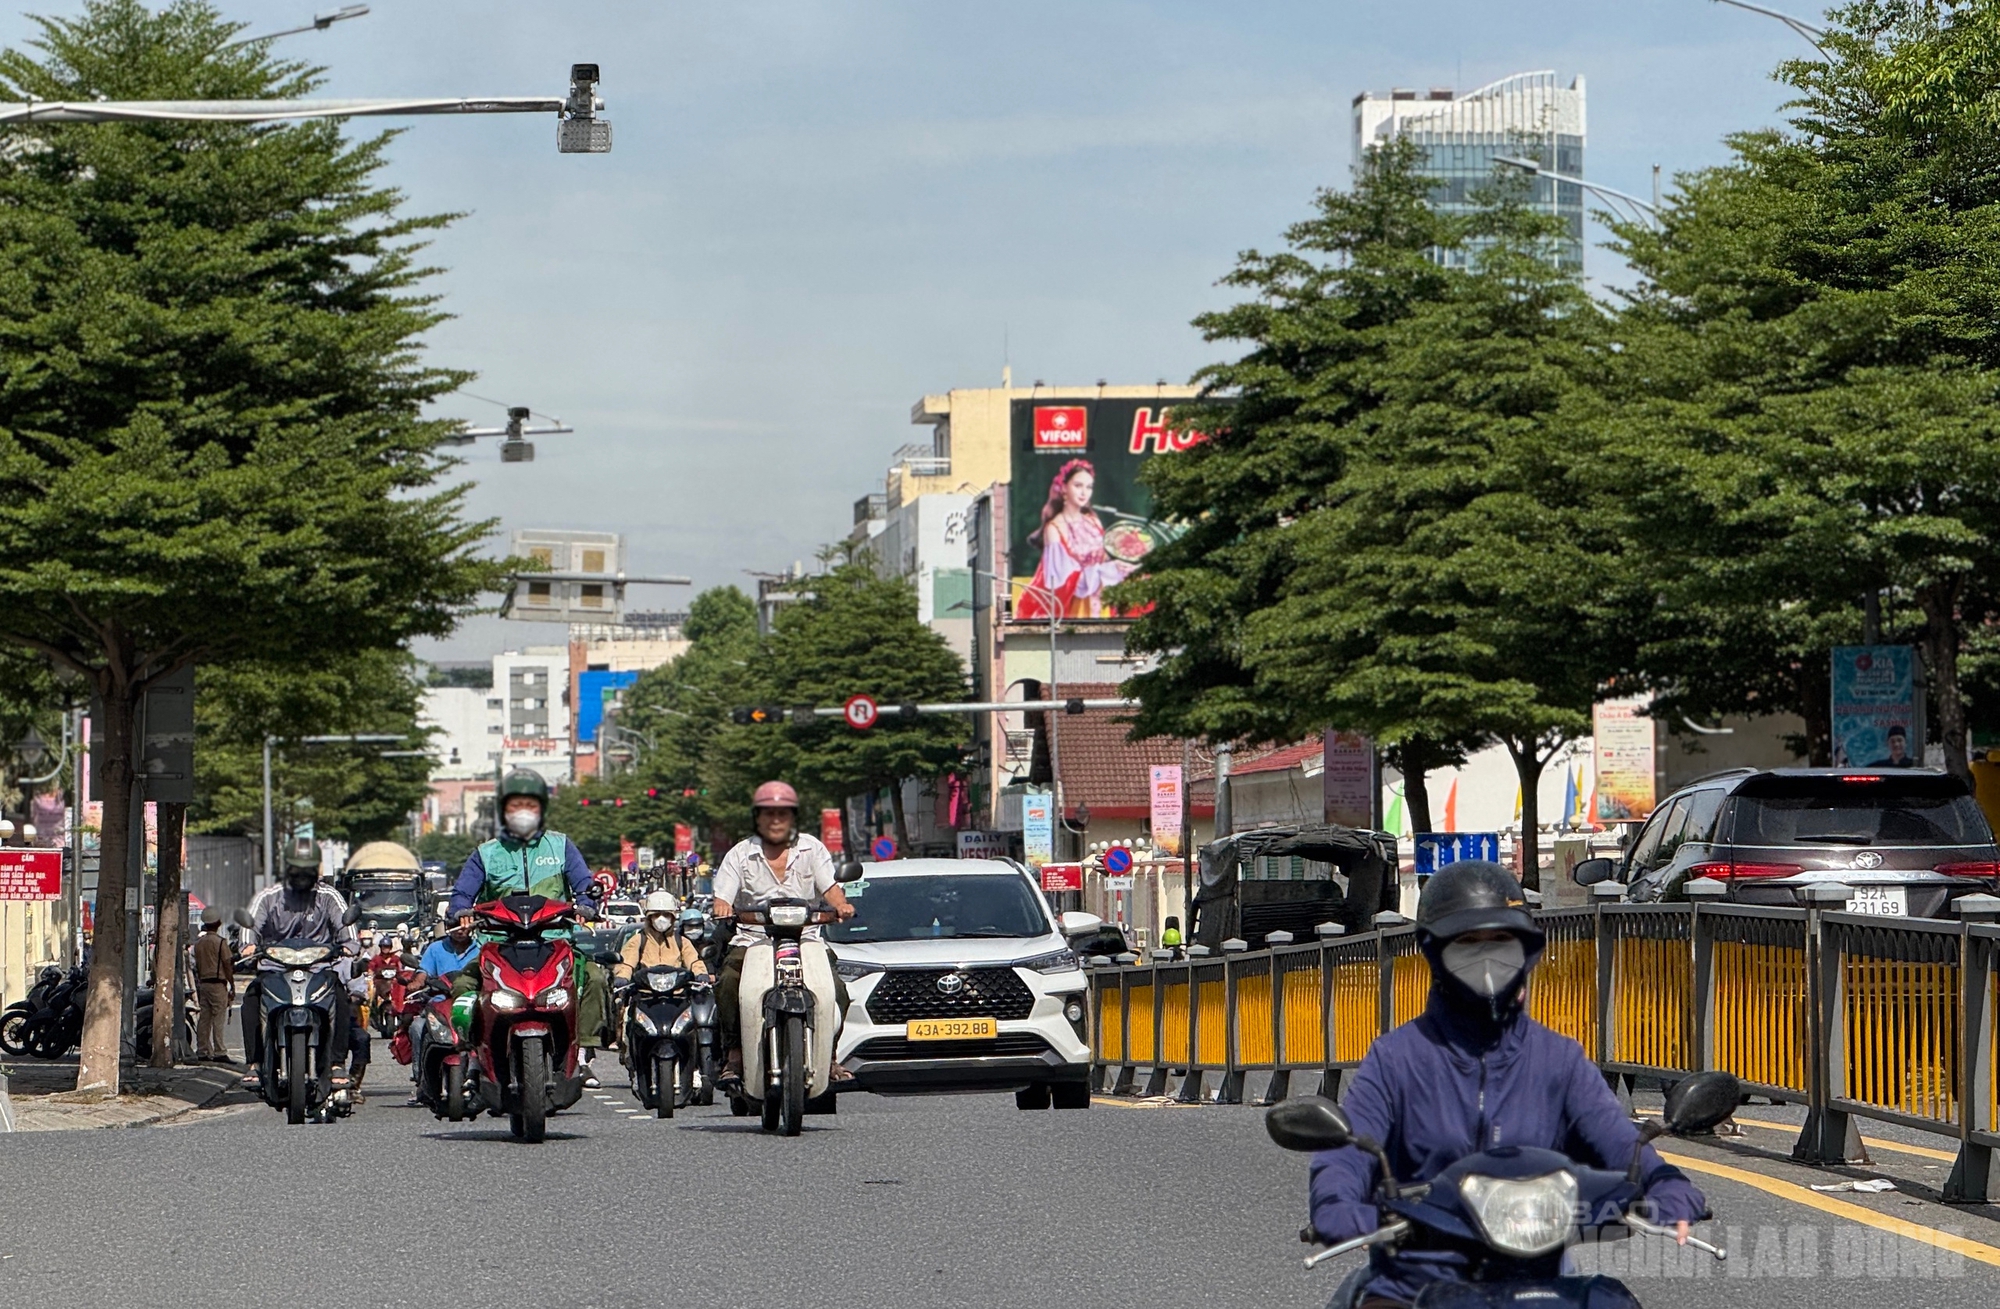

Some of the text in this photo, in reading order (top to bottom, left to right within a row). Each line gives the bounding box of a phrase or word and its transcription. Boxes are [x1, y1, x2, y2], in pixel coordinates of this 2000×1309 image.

[1039, 429, 1083, 442] VIFON
[535, 856, 560, 866] Grab
[1860, 887, 1888, 900] 92A
[1849, 901, 1900, 915] 231.69
[915, 1022, 989, 1037] 43A-392.88
[1514, 1291, 1560, 1300] HONDA
